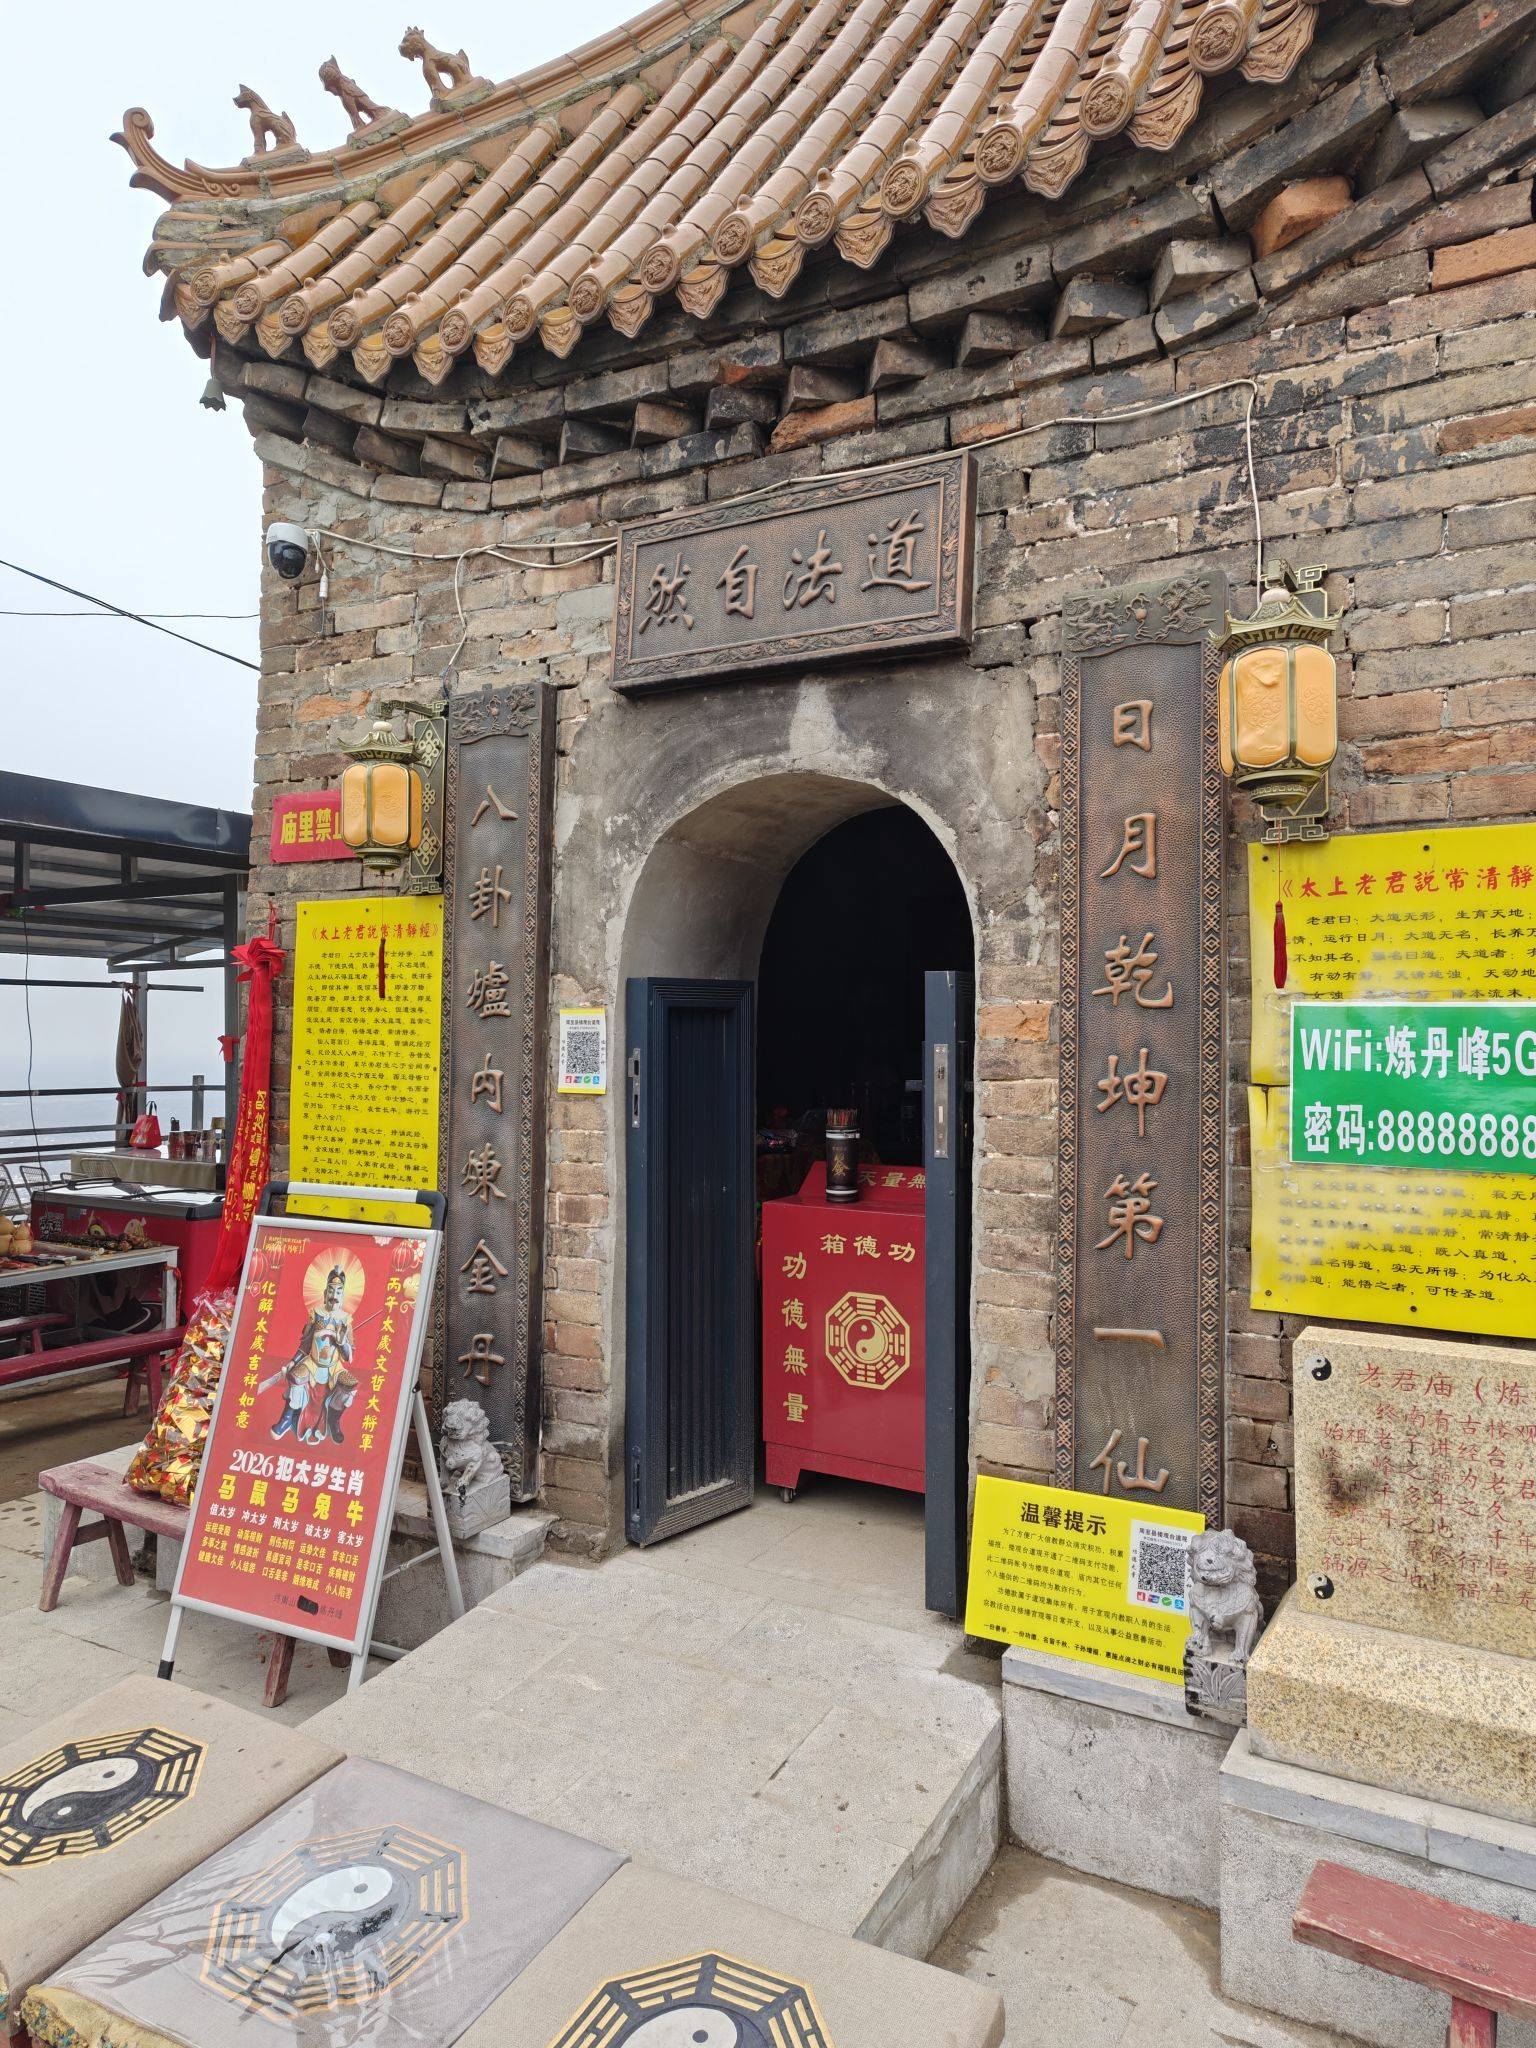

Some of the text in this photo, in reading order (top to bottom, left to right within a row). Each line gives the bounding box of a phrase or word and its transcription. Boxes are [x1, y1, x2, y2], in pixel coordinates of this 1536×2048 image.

[1090, 700, 1173, 1495] 日月乾坤第一仙
[780, 1251, 810, 1424] 功德無量
[218, 1474, 364, 1527] 马 鼠 马 兔 牛
[1021, 1501, 1107, 1536] 温馨提示
[241, 1510, 267, 1526] 冲太岁
[273, 1516, 300, 1534] 刑太岁
[304, 1524, 331, 1541] 破太岁
[337, 1530, 364, 1548] 害太岁
